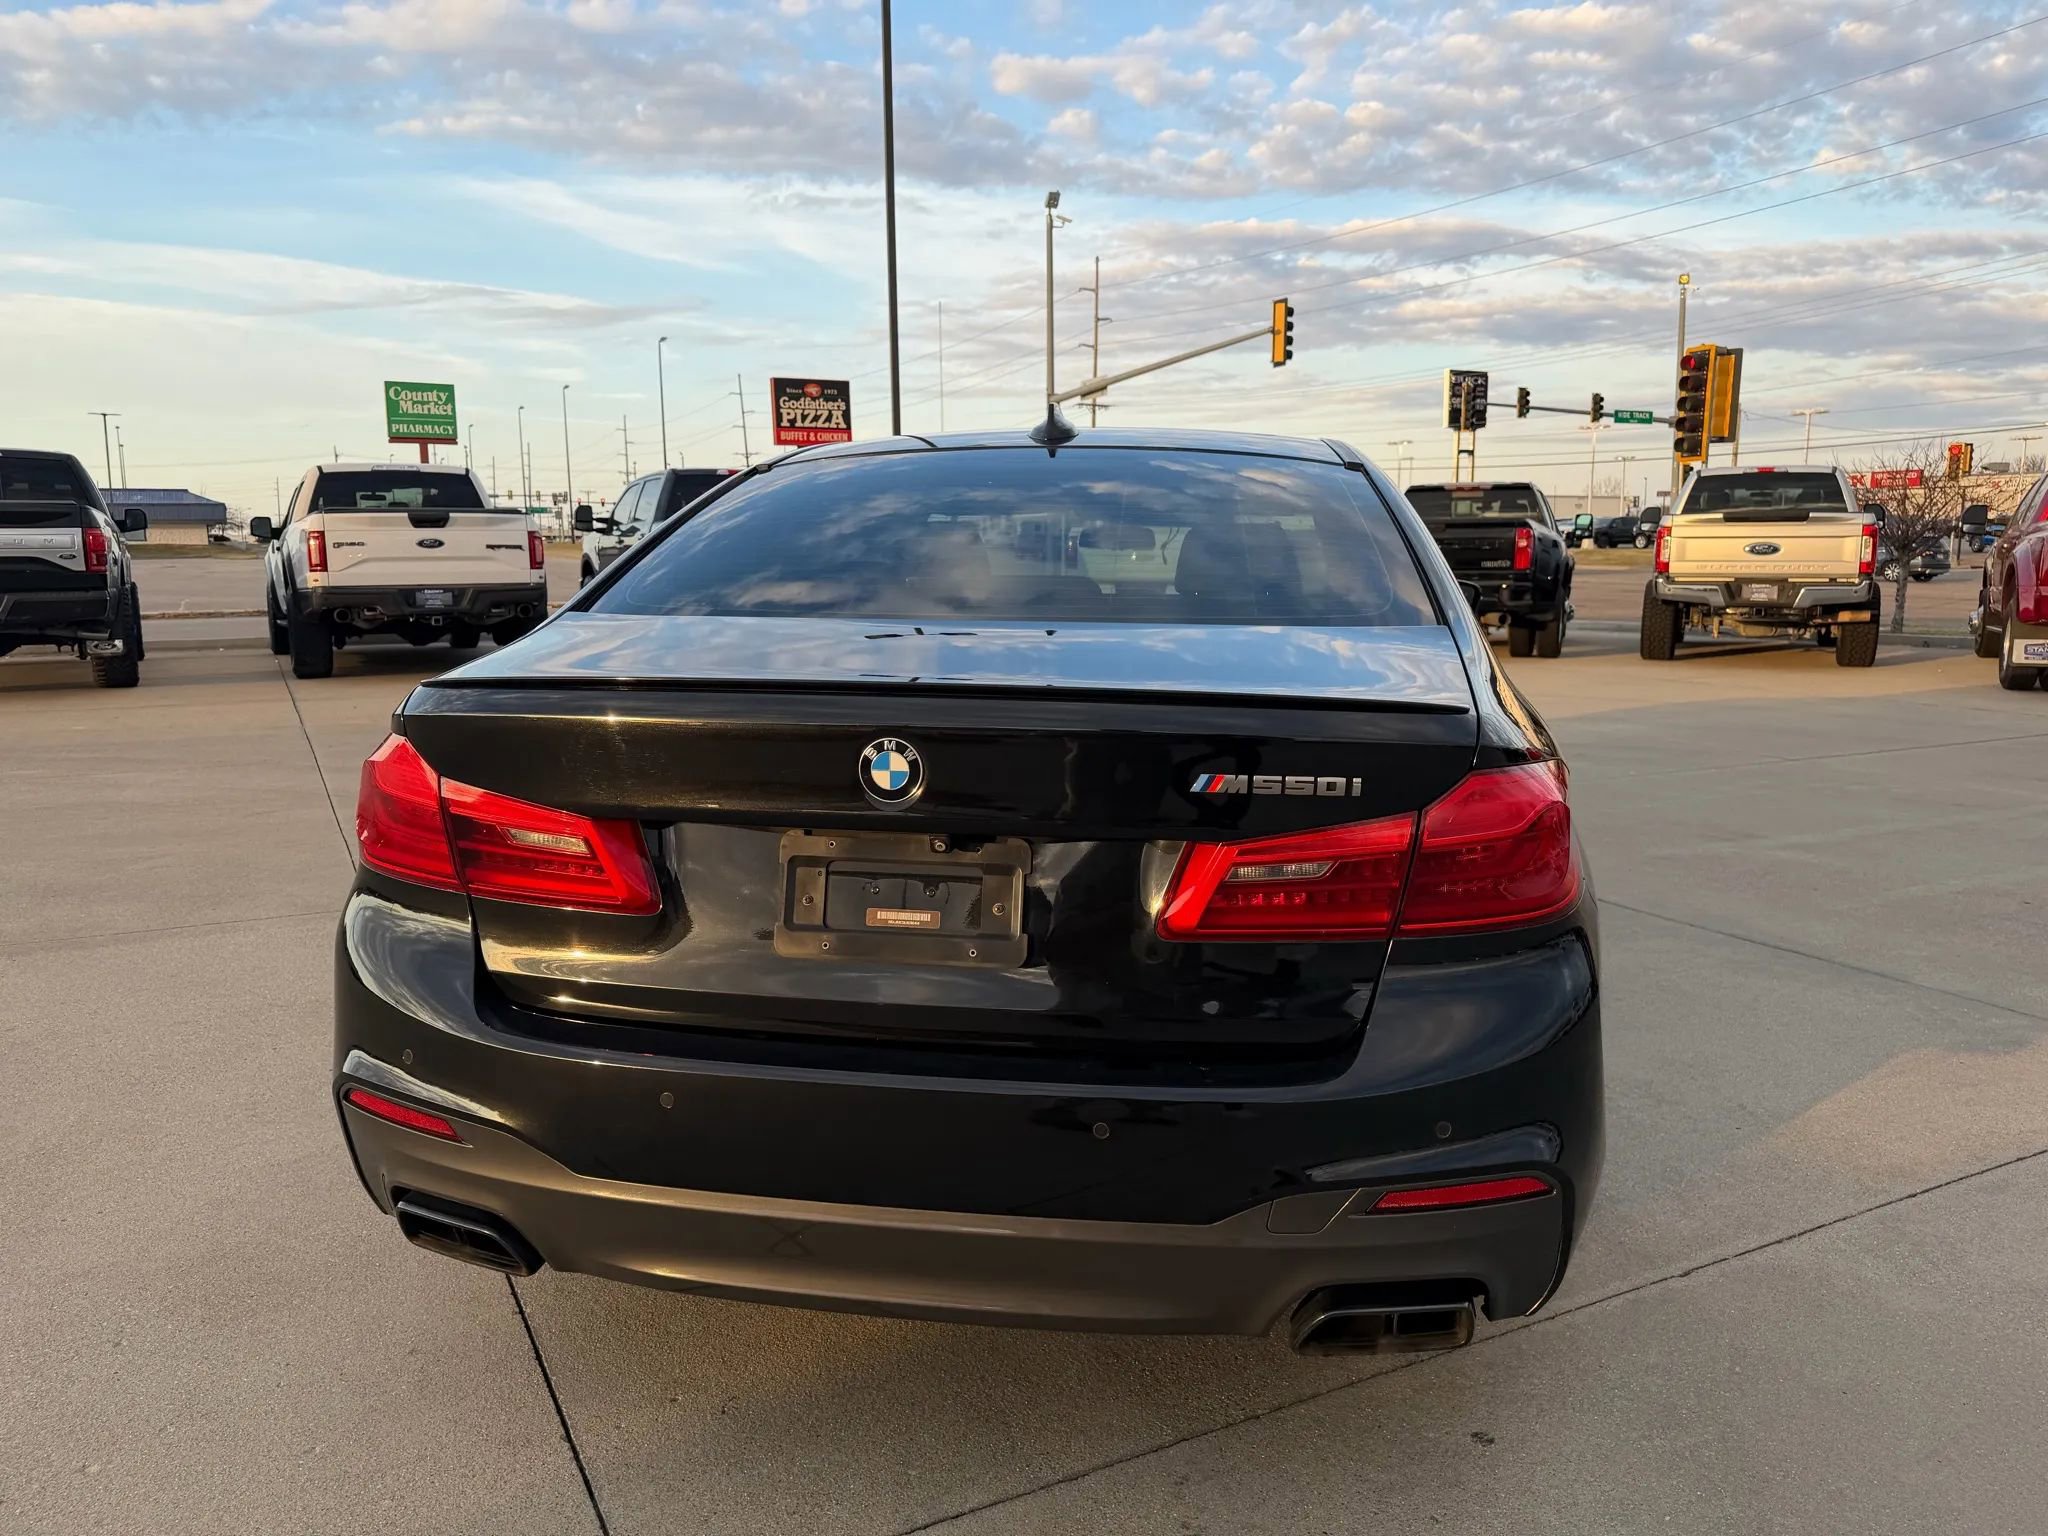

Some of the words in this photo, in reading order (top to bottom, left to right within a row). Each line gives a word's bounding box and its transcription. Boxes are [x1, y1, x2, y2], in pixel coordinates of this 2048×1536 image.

[389, 386, 449, 404] County
[779, 396, 846, 410] Godfather's
[399, 400, 453, 416] Market
[1633, 411, 1650, 419] TRACK
[780, 408, 847, 429] PIZZA
[392, 423, 455, 435] PHARMACY
[780, 431, 808, 441] BUFFET
[809, 432, 816, 441] &
[817, 432, 848, 442] CHICKEN
[864, 740, 917, 762] BMW
[1217, 774, 1362, 797] M550i
